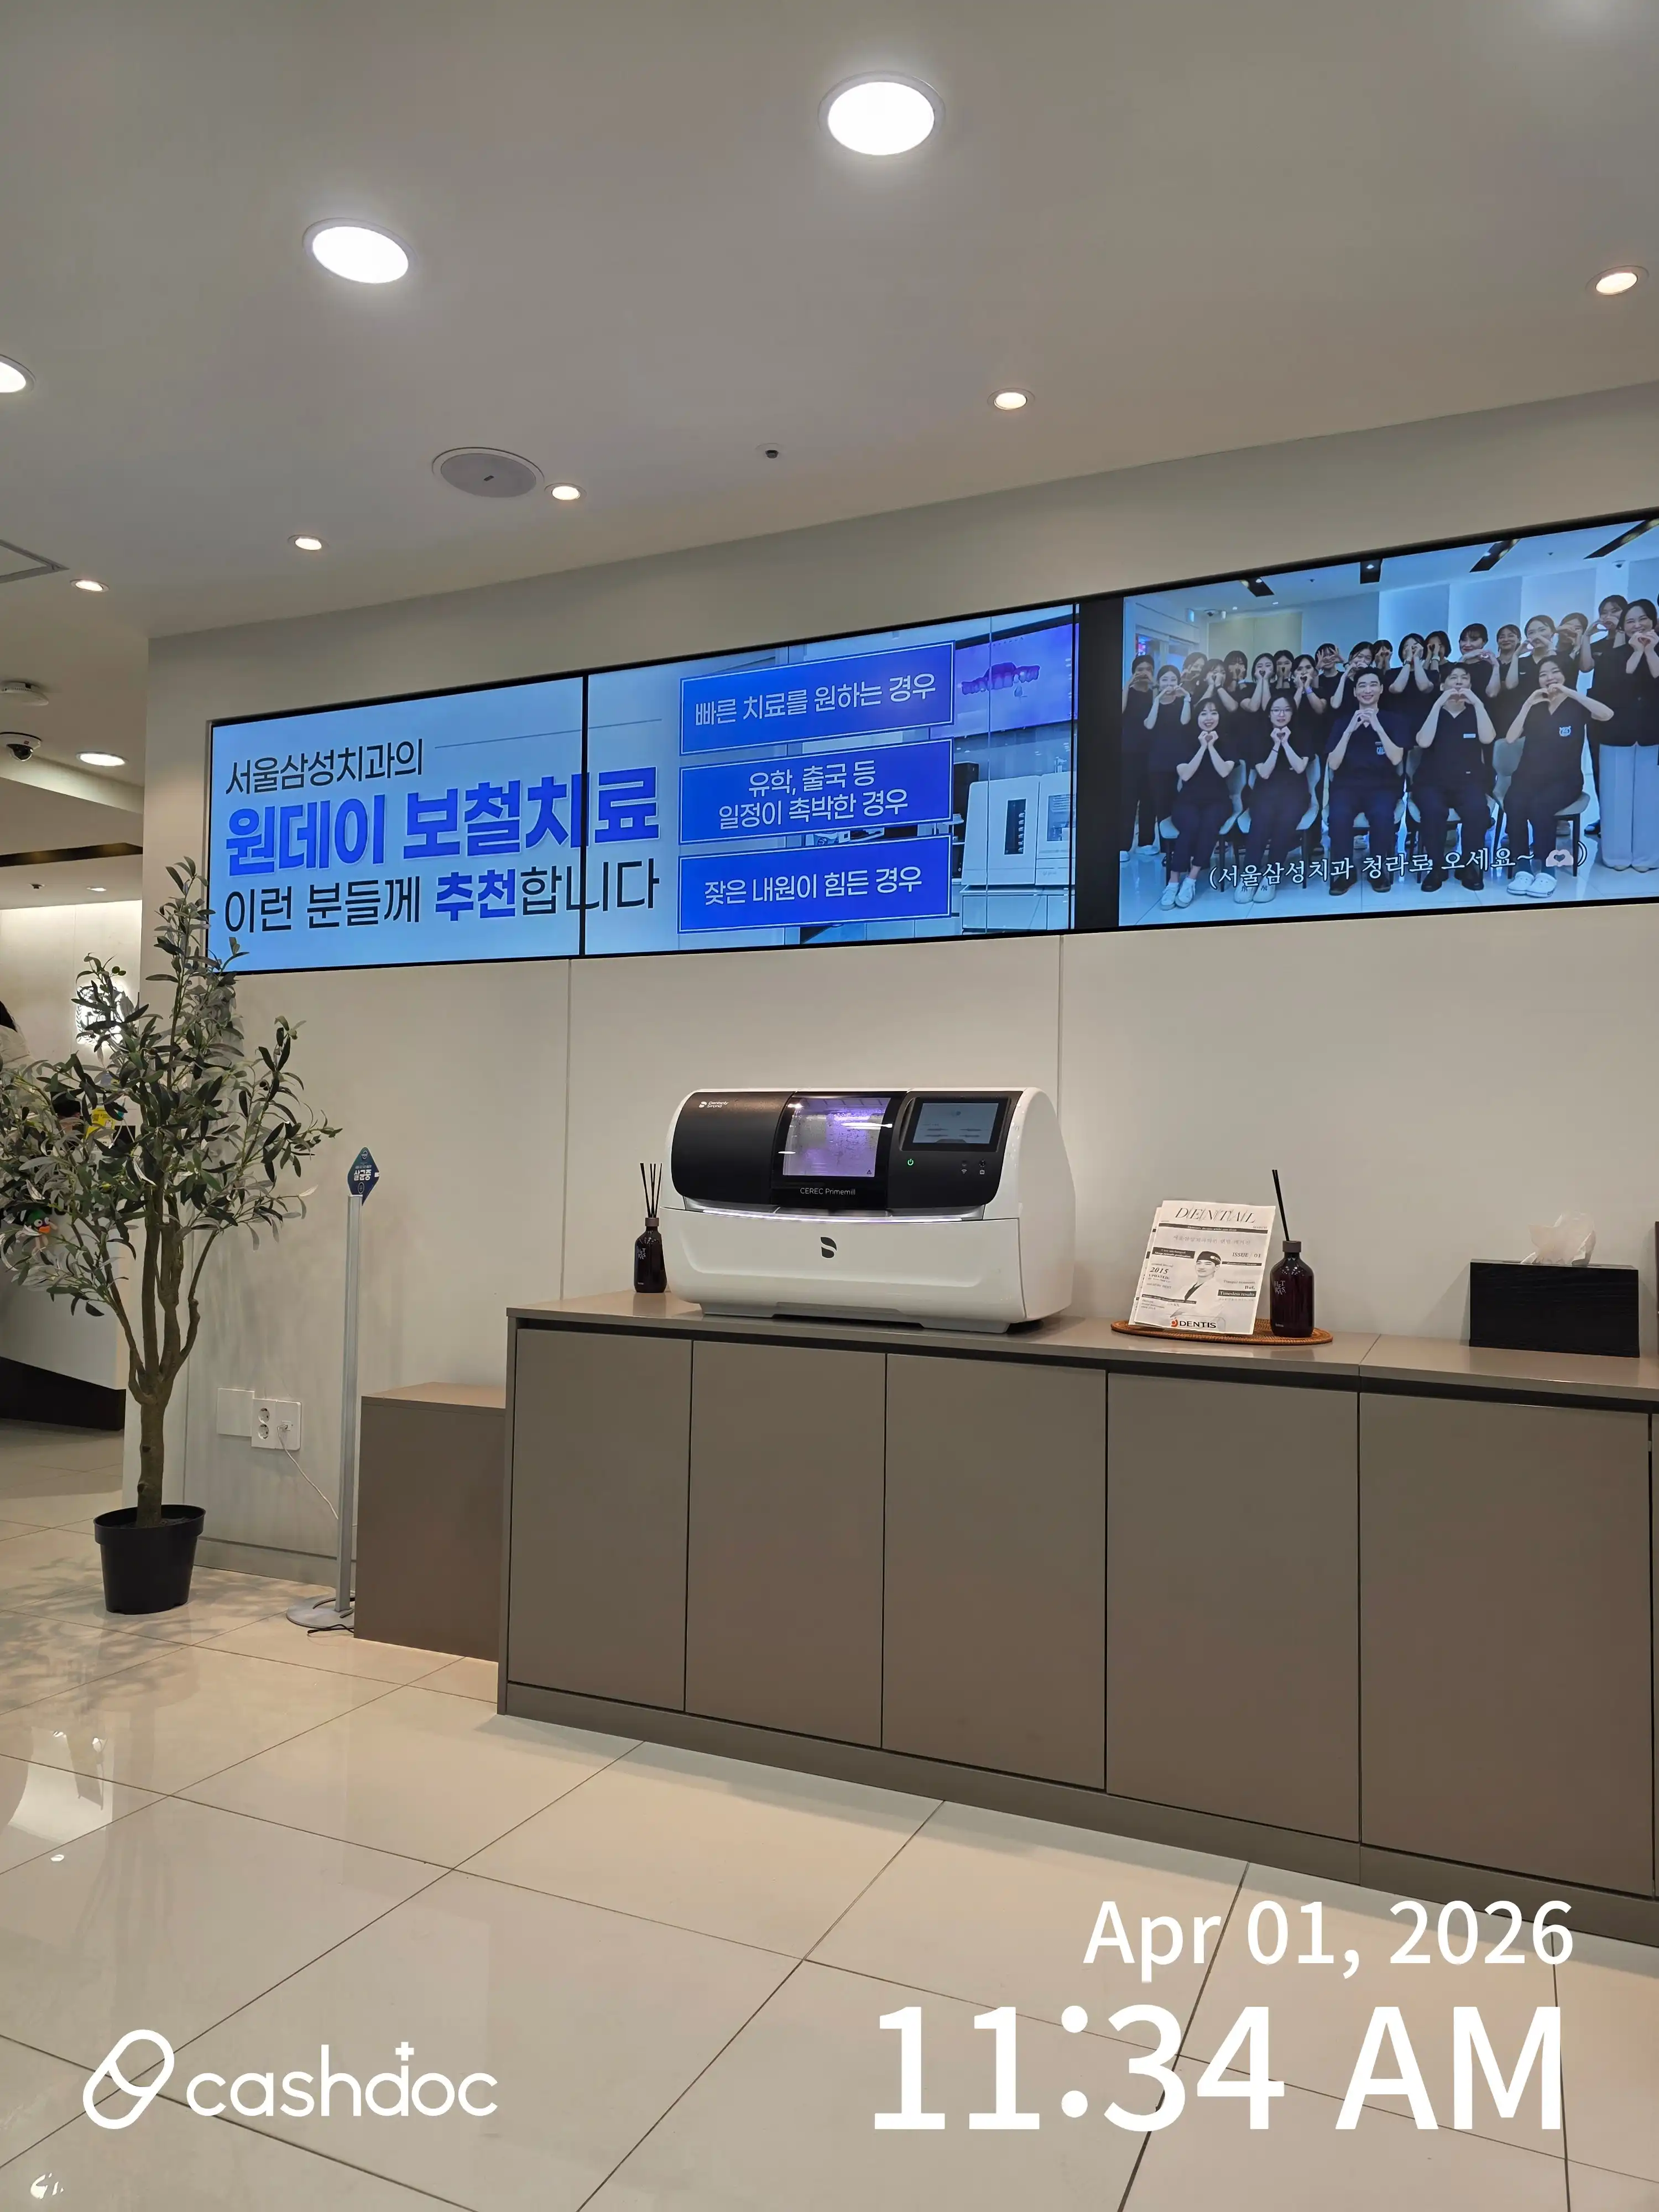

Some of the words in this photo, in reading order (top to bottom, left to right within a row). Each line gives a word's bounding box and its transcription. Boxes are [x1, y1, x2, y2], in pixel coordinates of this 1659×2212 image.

[695, 699, 737, 726] 빠른
[743, 688, 807, 721] 치료를
[814, 681, 882, 712] 원하는
[889, 673, 936, 703] 경우
[225, 739, 423, 795] 서울삼성치과의
[749, 769, 796, 797] 유학,
[802, 763, 847, 791] 출국
[853, 760, 875, 786] 등
[226, 794, 385, 876] 원데이
[404, 766, 660, 859] 보철치료
[719, 800, 782, 830] 일정이
[789, 794, 857, 822] 촉박한
[862, 789, 907, 817] 경우
[705, 879, 747, 905] 잦은
[752, 873, 817, 902] 내원이
[824, 869, 869, 896] 힘든
[875, 867, 922, 893] 경우
[1209, 857, 1353, 890] (서울삼성치과
[1361, 852, 1433, 879] 청라로
[225, 886, 291, 933] 이런
[307, 876, 420, 928] 분들께
[436, 858, 660, 921] 추천합니다
[354, 1169, 372, 1181] 살균중
